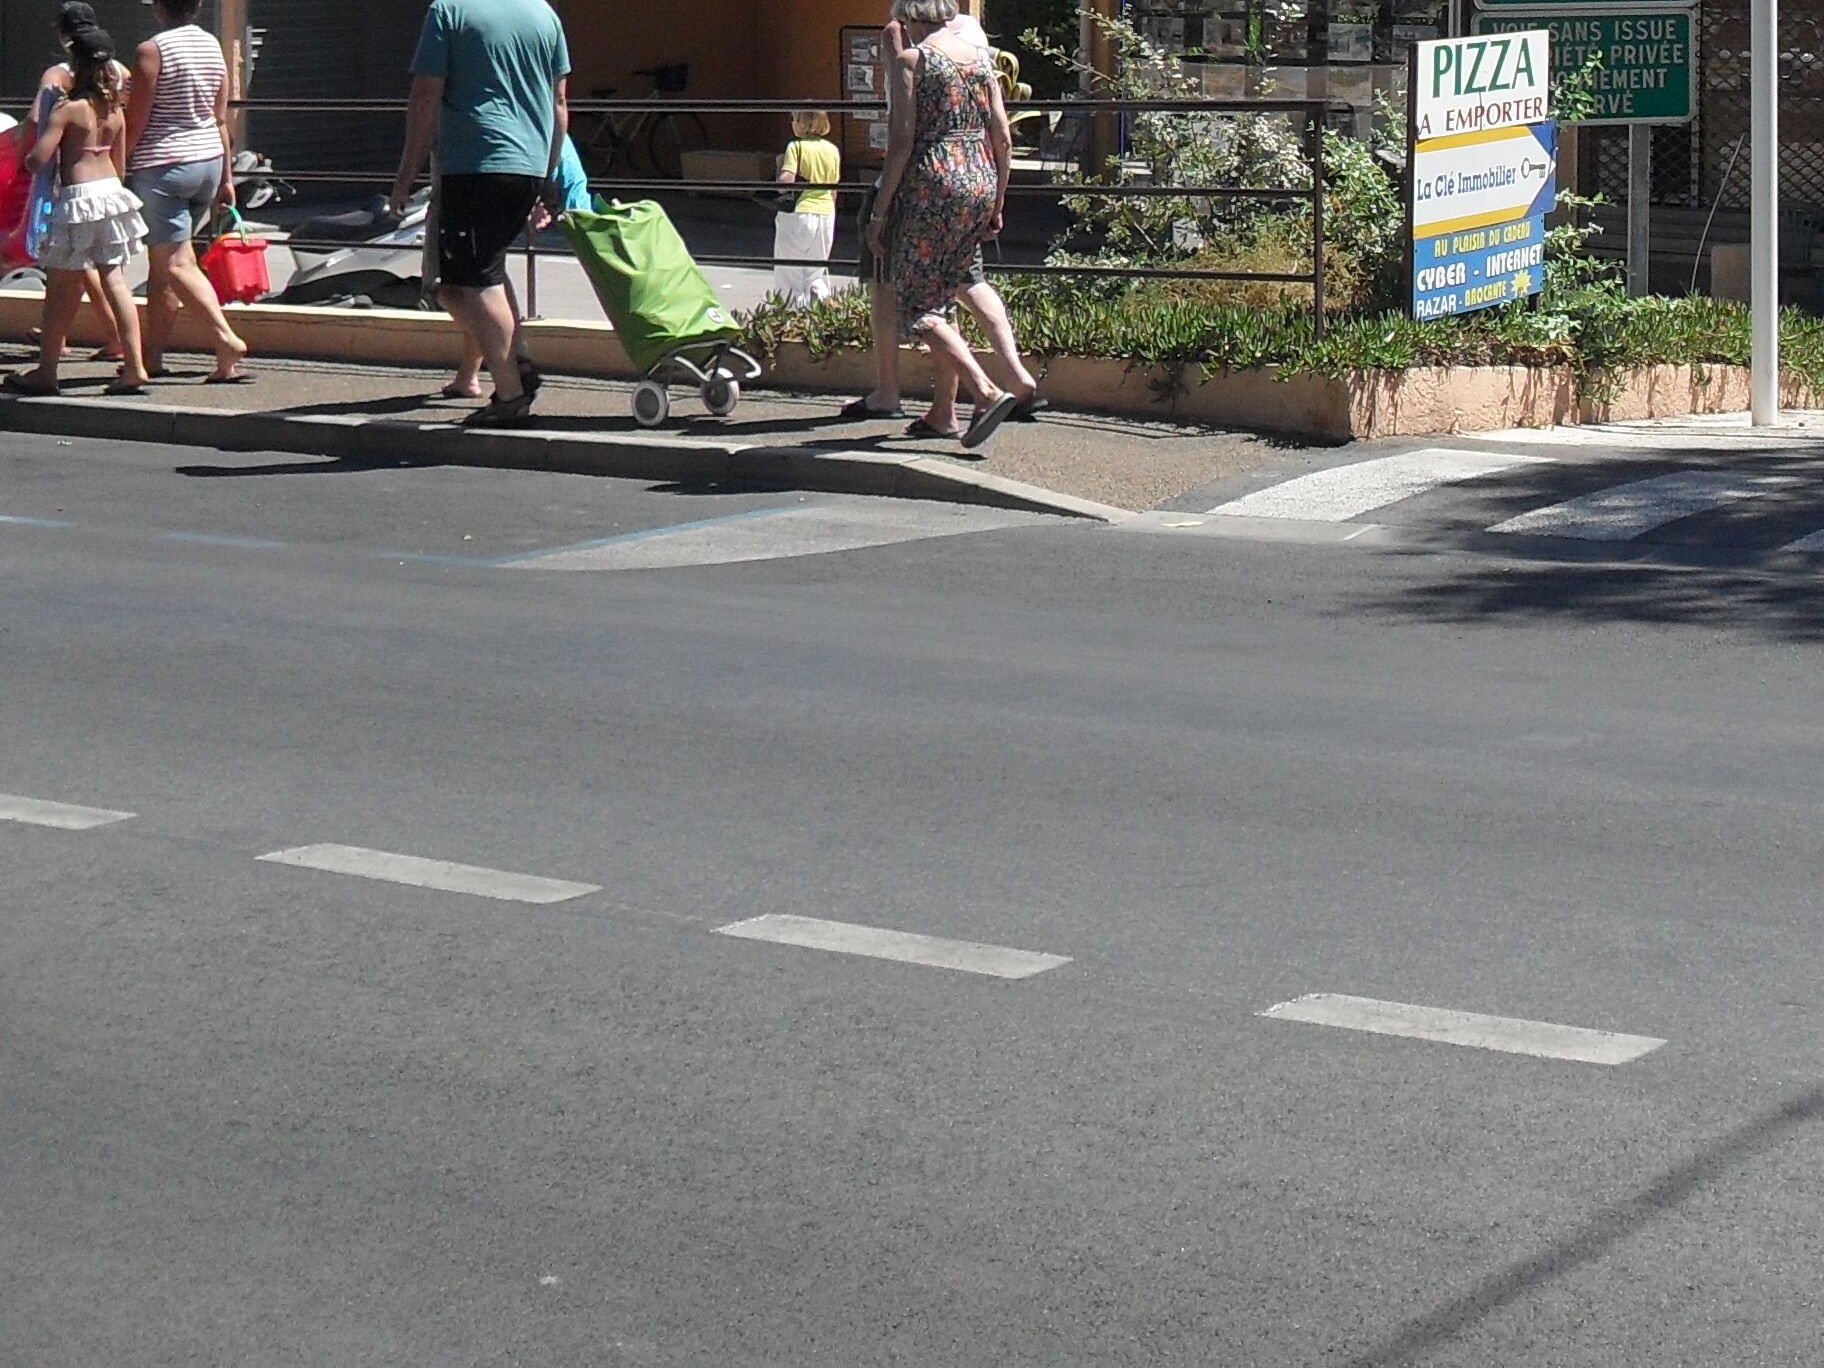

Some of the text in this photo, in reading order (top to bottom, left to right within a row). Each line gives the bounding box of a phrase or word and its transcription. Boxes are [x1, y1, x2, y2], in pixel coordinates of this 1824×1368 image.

[1549, 21, 1602, 42] SANS
[1614, 18, 1677, 41] ISSUE
[1433, 38, 1535, 98] PIZZA
[1610, 40, 1684, 65] PRIVÉE
[1419, 97, 1543, 135] A EMPORTER
[1417, 165, 1517, 201] La Clé Immobilier
[1434, 221, 1531, 258] AU PLAISIR DU CADEAU
[1416, 262, 1466, 292] CYBER
[1486, 243, 1542, 278] INTERNET
[1464, 280, 1507, 307] BROCANTE
